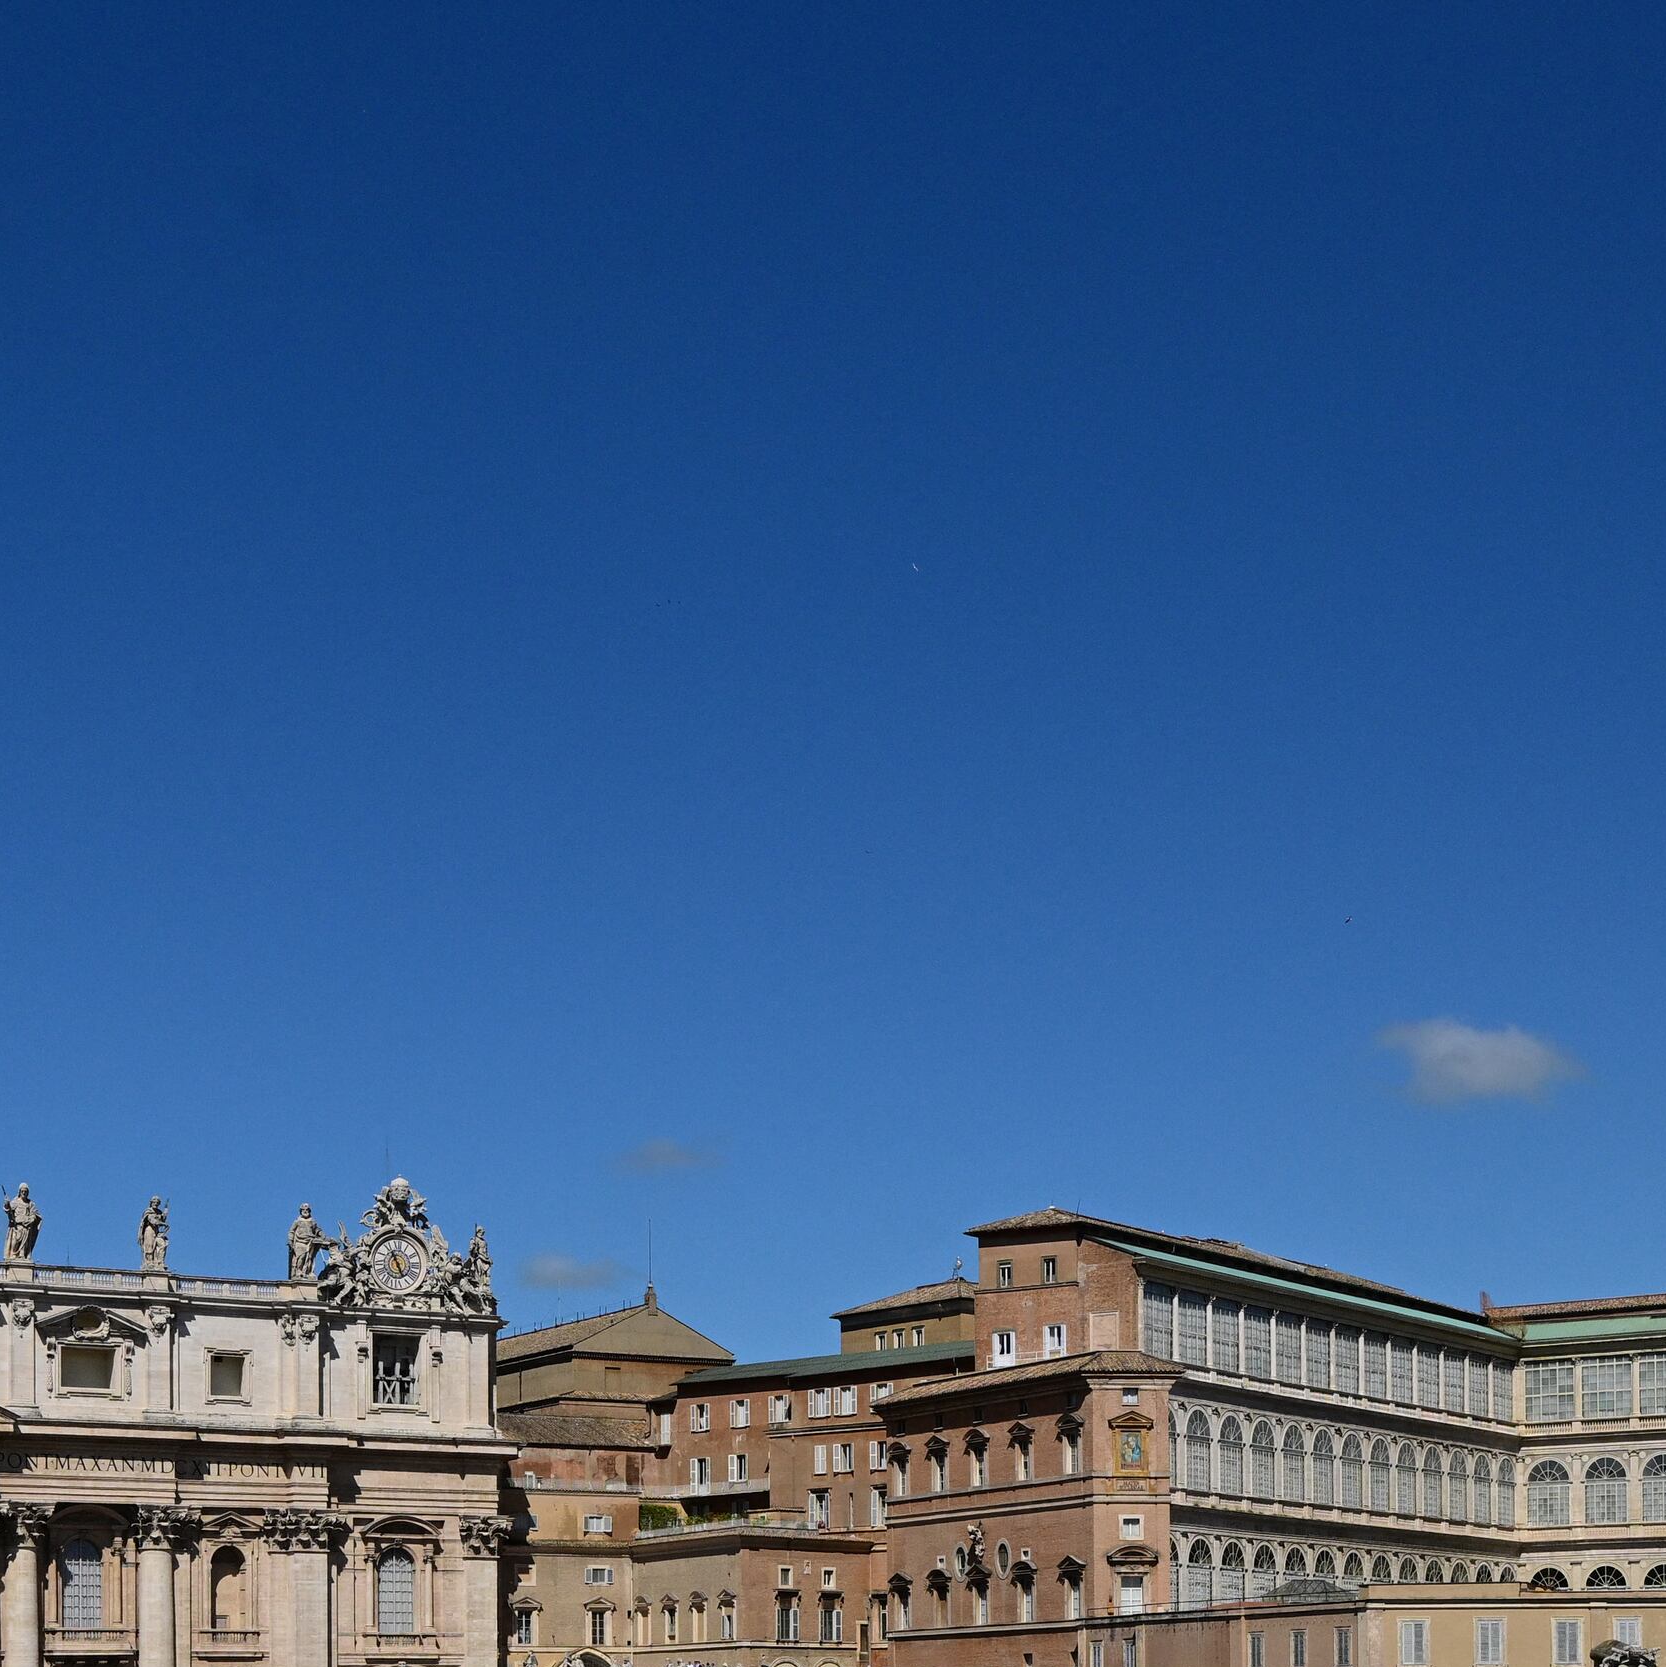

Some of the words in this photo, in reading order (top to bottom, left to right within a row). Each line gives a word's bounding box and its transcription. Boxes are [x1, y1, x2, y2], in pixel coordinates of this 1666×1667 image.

[54, 1454, 103, 1473] MAX
[107, 1456, 136, 1473] AN
[139, 1458, 220, 1477] MDCXII
[227, 1461, 283, 1479] PONT
[296, 1462, 326, 1479] VII
